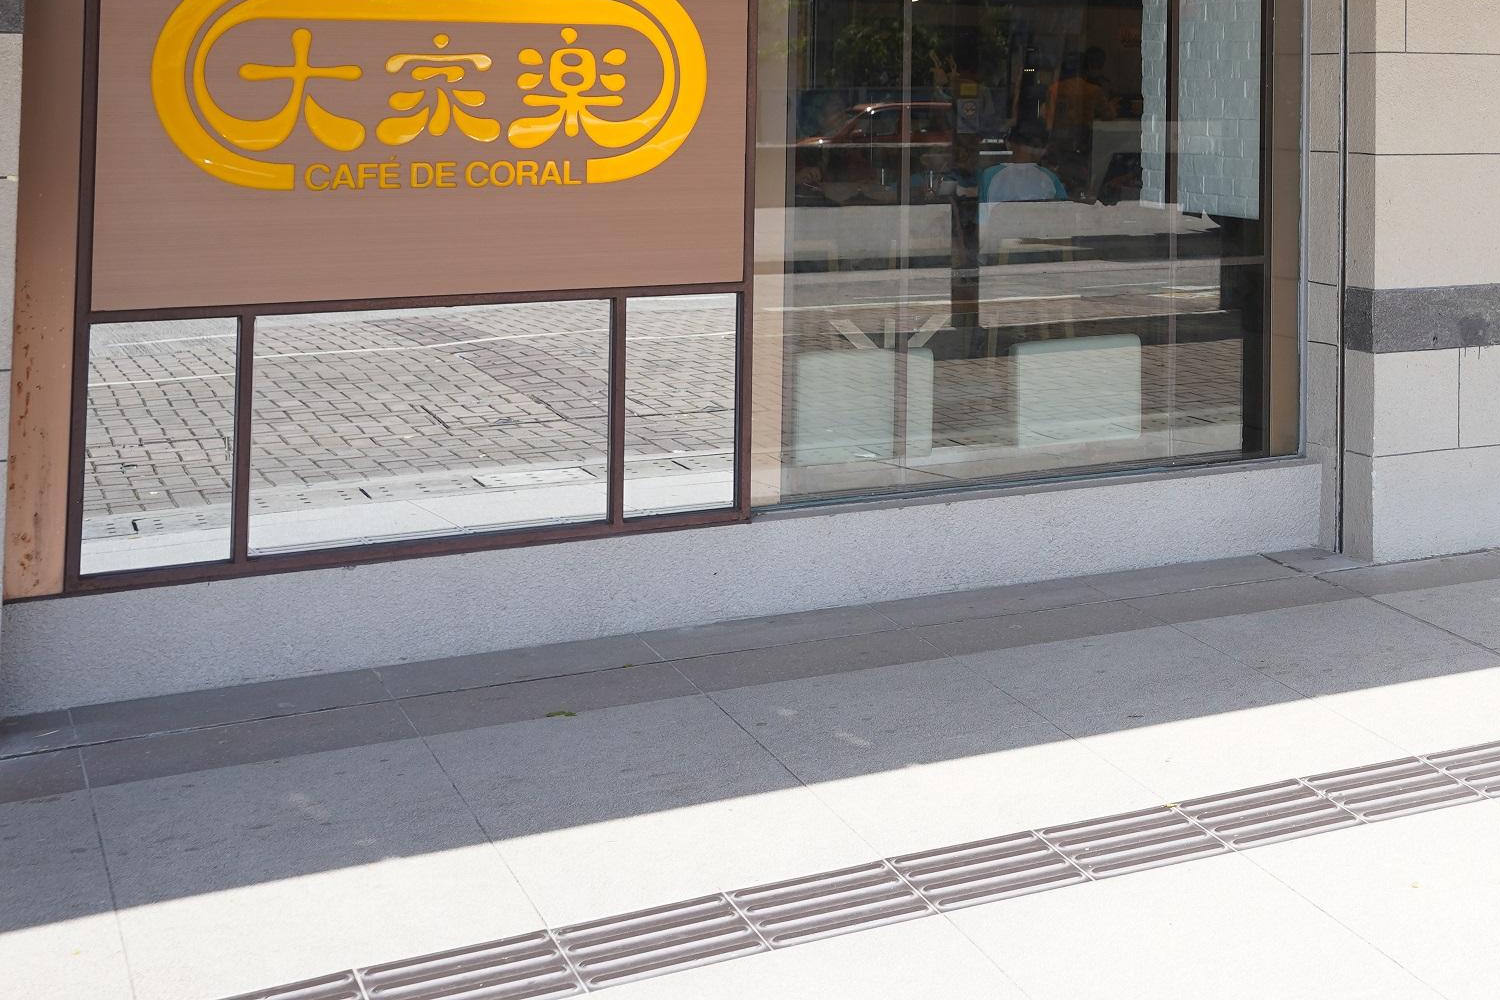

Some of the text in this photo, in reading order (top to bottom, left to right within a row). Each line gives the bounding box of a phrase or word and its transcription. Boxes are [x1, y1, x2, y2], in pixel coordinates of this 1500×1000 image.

[304, 155, 583, 191] CAFÉ DE CORAL
